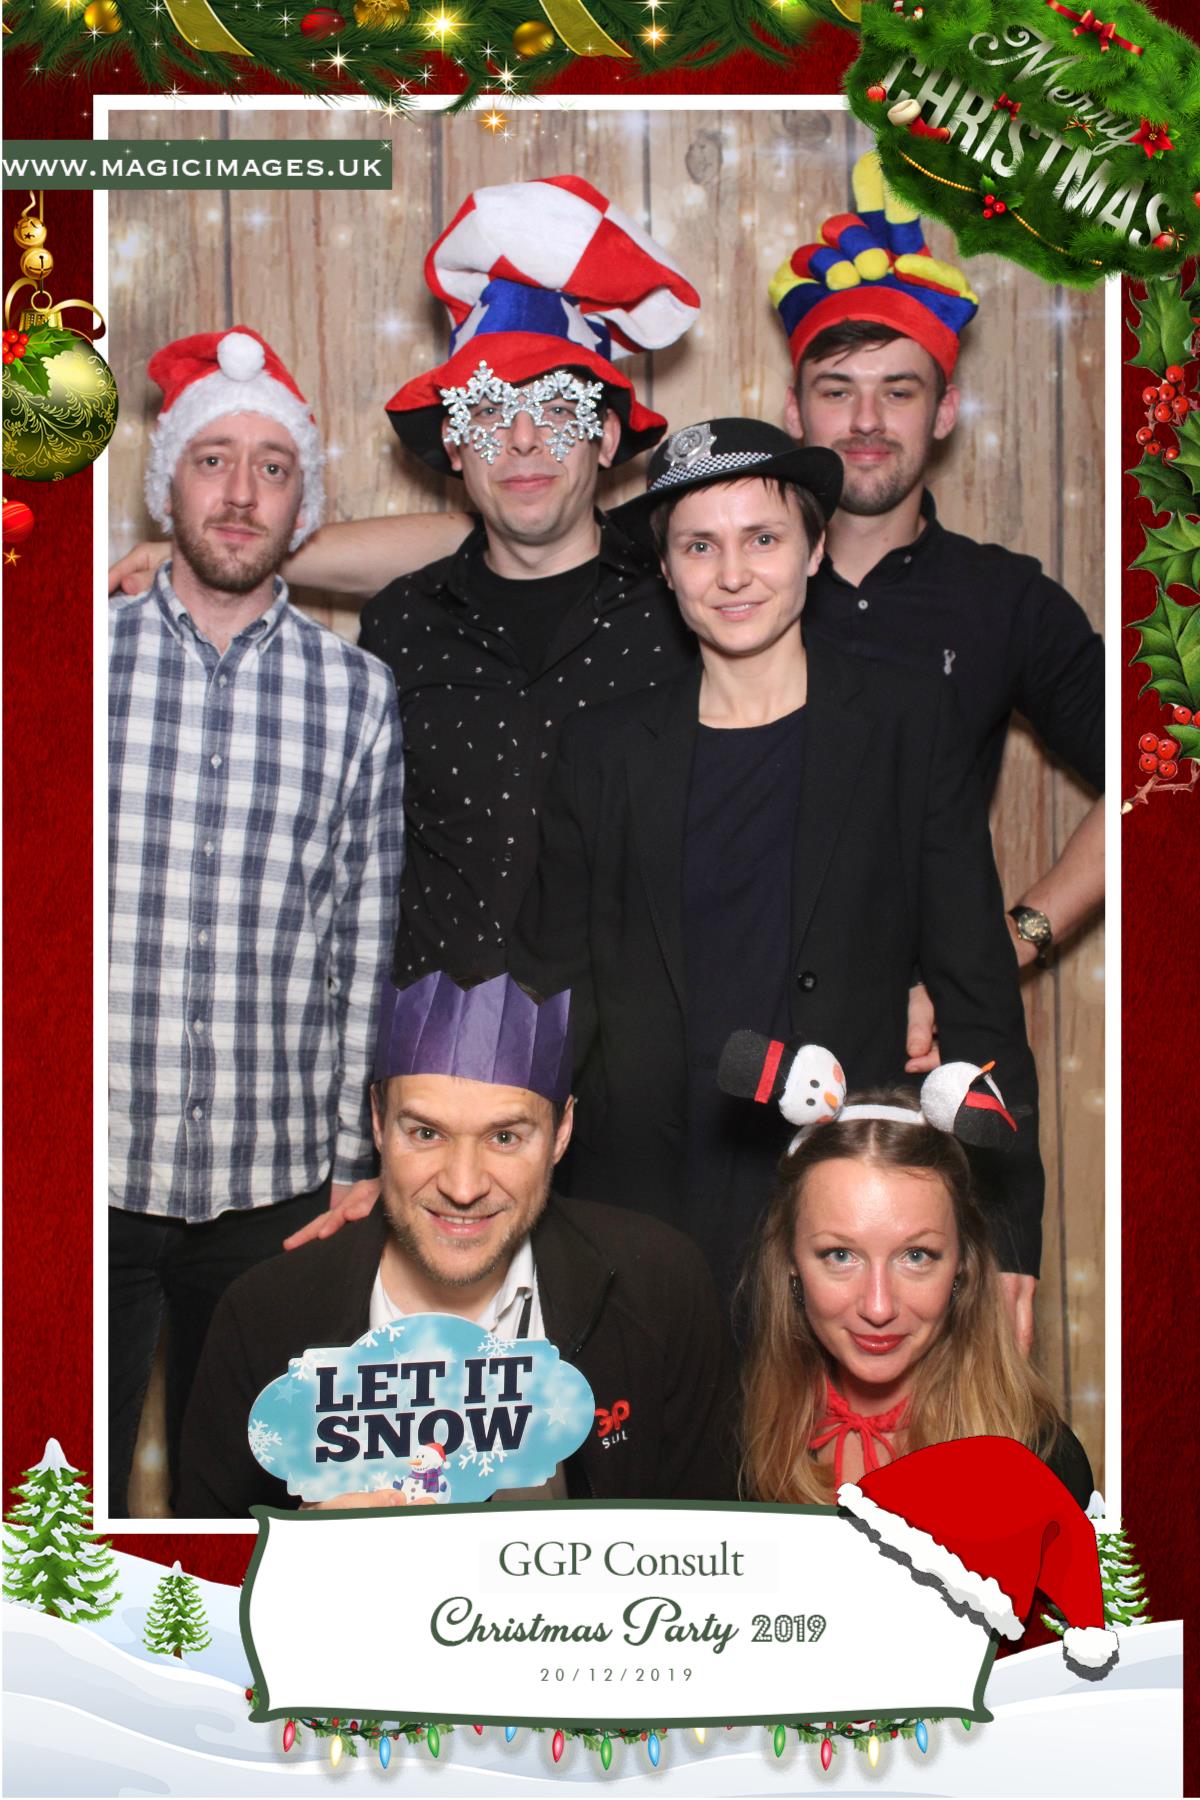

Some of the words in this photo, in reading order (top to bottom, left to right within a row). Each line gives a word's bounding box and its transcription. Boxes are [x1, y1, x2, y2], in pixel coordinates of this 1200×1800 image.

[315, 1360, 446, 1413] LET
[463, 1356, 533, 1404] IT
[315, 1405, 533, 1463] SNOW
